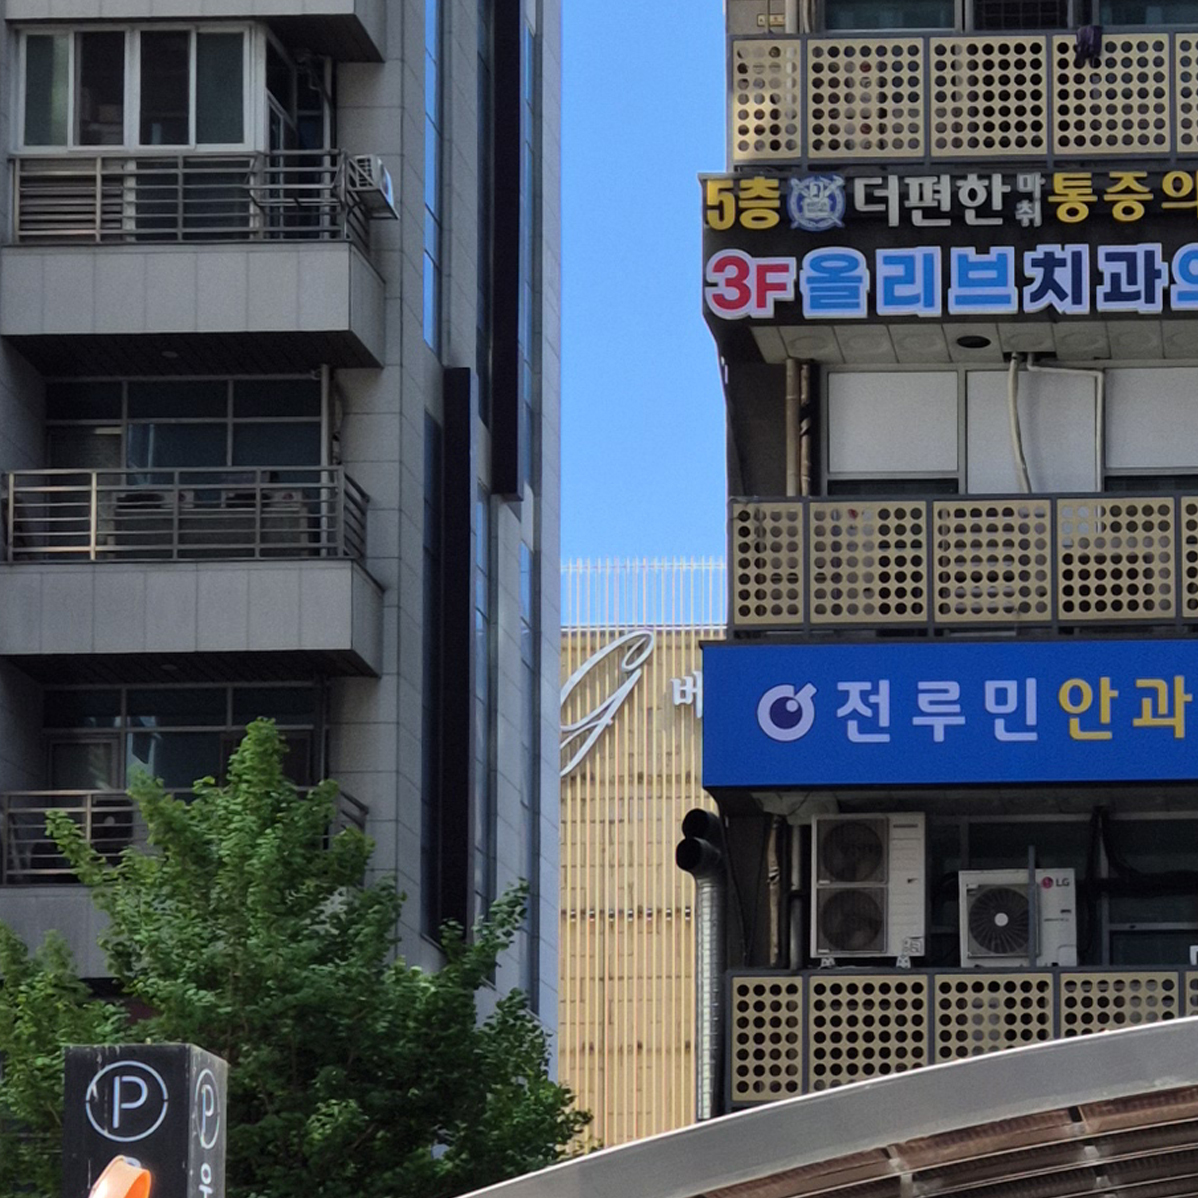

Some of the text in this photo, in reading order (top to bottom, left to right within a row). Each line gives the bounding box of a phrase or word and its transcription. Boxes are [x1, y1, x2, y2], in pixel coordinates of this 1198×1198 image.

[706, 176, 780, 229] 5층
[853, 174, 1009, 227] 더편한
[711, 253, 793, 314] 3F
[1056, 878, 1070, 887] LG
